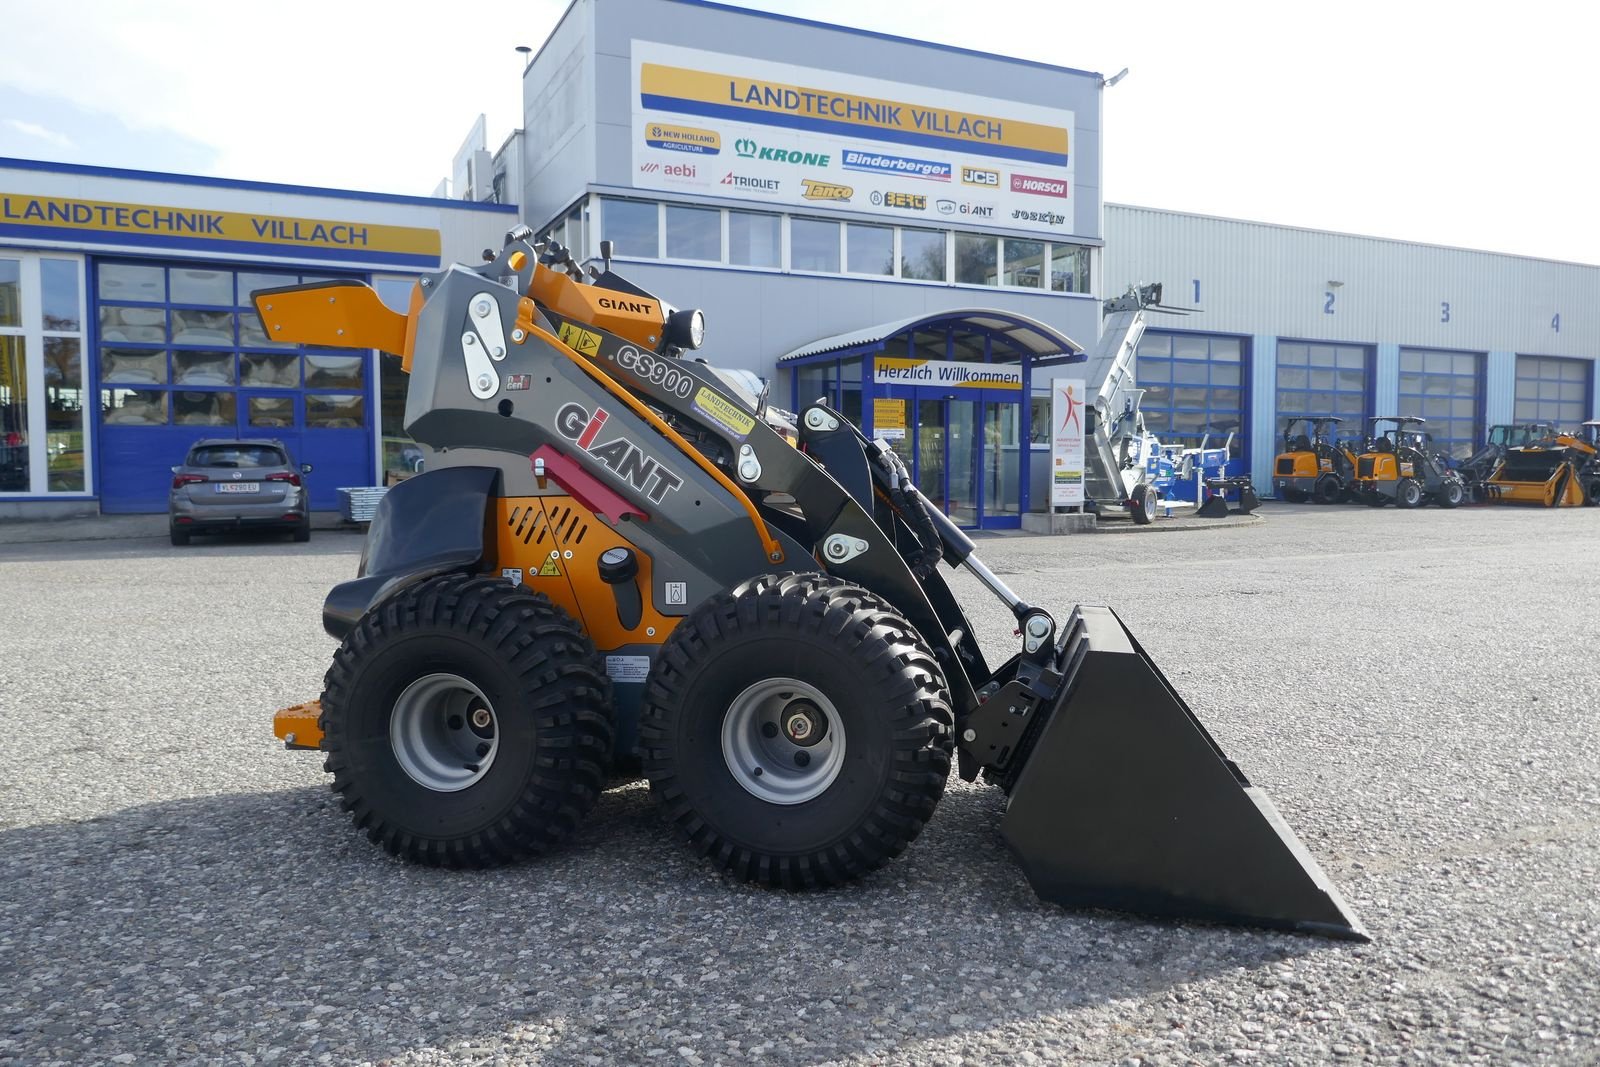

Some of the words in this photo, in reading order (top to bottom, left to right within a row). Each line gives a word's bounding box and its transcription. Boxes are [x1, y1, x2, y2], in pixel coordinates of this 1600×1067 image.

[730, 81, 902, 126] LANDTECHNIK
[912, 109, 1003, 141] VILLACH
[662, 142, 703, 153] AGRICULTURE
[663, 130, 680, 139] NEW
[681, 133, 715, 143] HOLLAND
[759, 146, 831, 168] KRONE
[845, 152, 949, 176] Binderberger
[664, 164, 696, 178] aebi
[963, 169, 999, 186] JCB
[733, 176, 780, 190] TRIOLIET
[801, 179, 854, 201] Tanco
[1022, 179, 1065, 194] HORSCH
[3, 198, 225, 235] LANDTECHNIK
[252, 218, 369, 247] VILLACH
[1192, 279, 1201, 304] 1
[1323, 291, 1335, 314] 2
[598, 298, 652, 315] GIANT
[1440, 301, 1450, 323] 3
[1550, 312, 1560, 333] 4
[616, 344, 694, 399] GS900
[878, 364, 932, 381] Herzlich
[938, 366, 1019, 384] Willkommen
[701, 390, 752, 427] LANDTECHNIK
